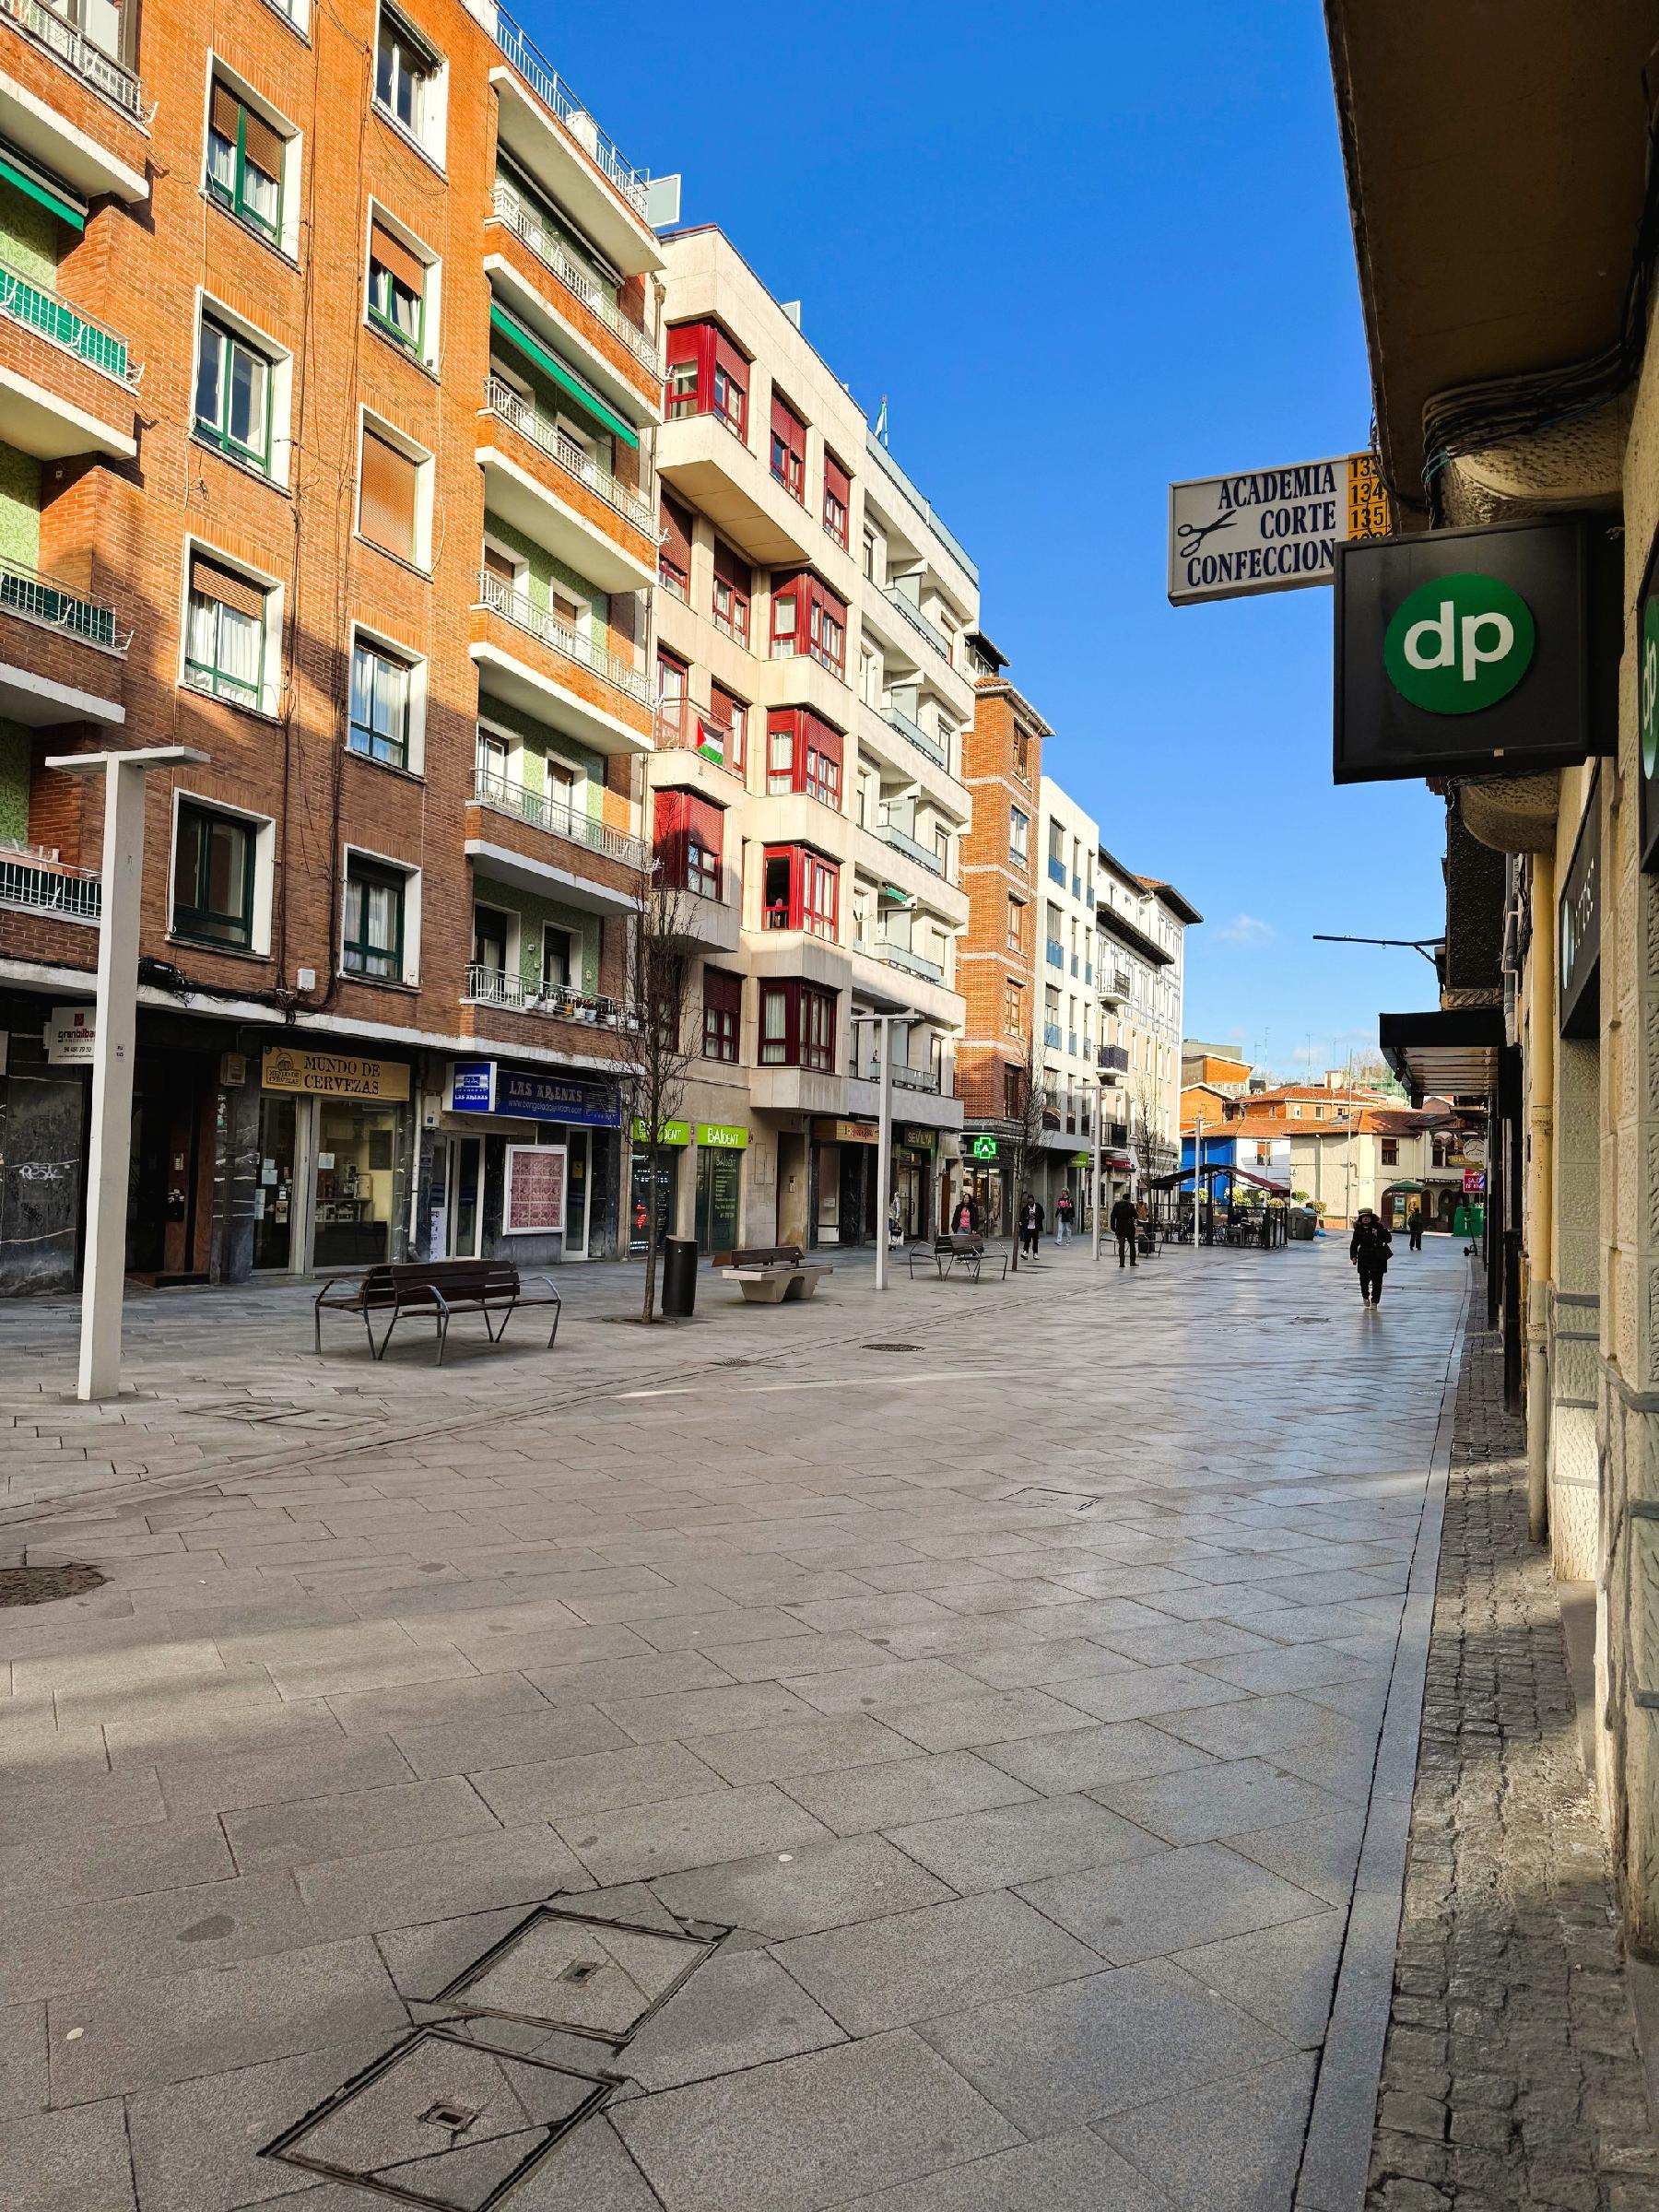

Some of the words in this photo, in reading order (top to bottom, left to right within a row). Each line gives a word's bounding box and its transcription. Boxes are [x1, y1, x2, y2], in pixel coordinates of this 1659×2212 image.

[1218, 464, 1337, 511] ACADEMIA
[1350, 481, 1384, 504] 134
[1260, 500, 1336, 539] CORTE
[1350, 506, 1384, 529] 135
[1187, 538, 1336, 587] CONFECCION
[1404, 601, 1514, 681] dp
[1643, 636, 1657, 736] dp
[304, 1055, 358, 1076] MUNDO
[361, 1062, 381, 1077] DE
[304, 1074, 379, 1095] CERVEZAS
[509, 1080, 533, 1097] LAS
[536, 1085, 582, 1102] ARENAS
